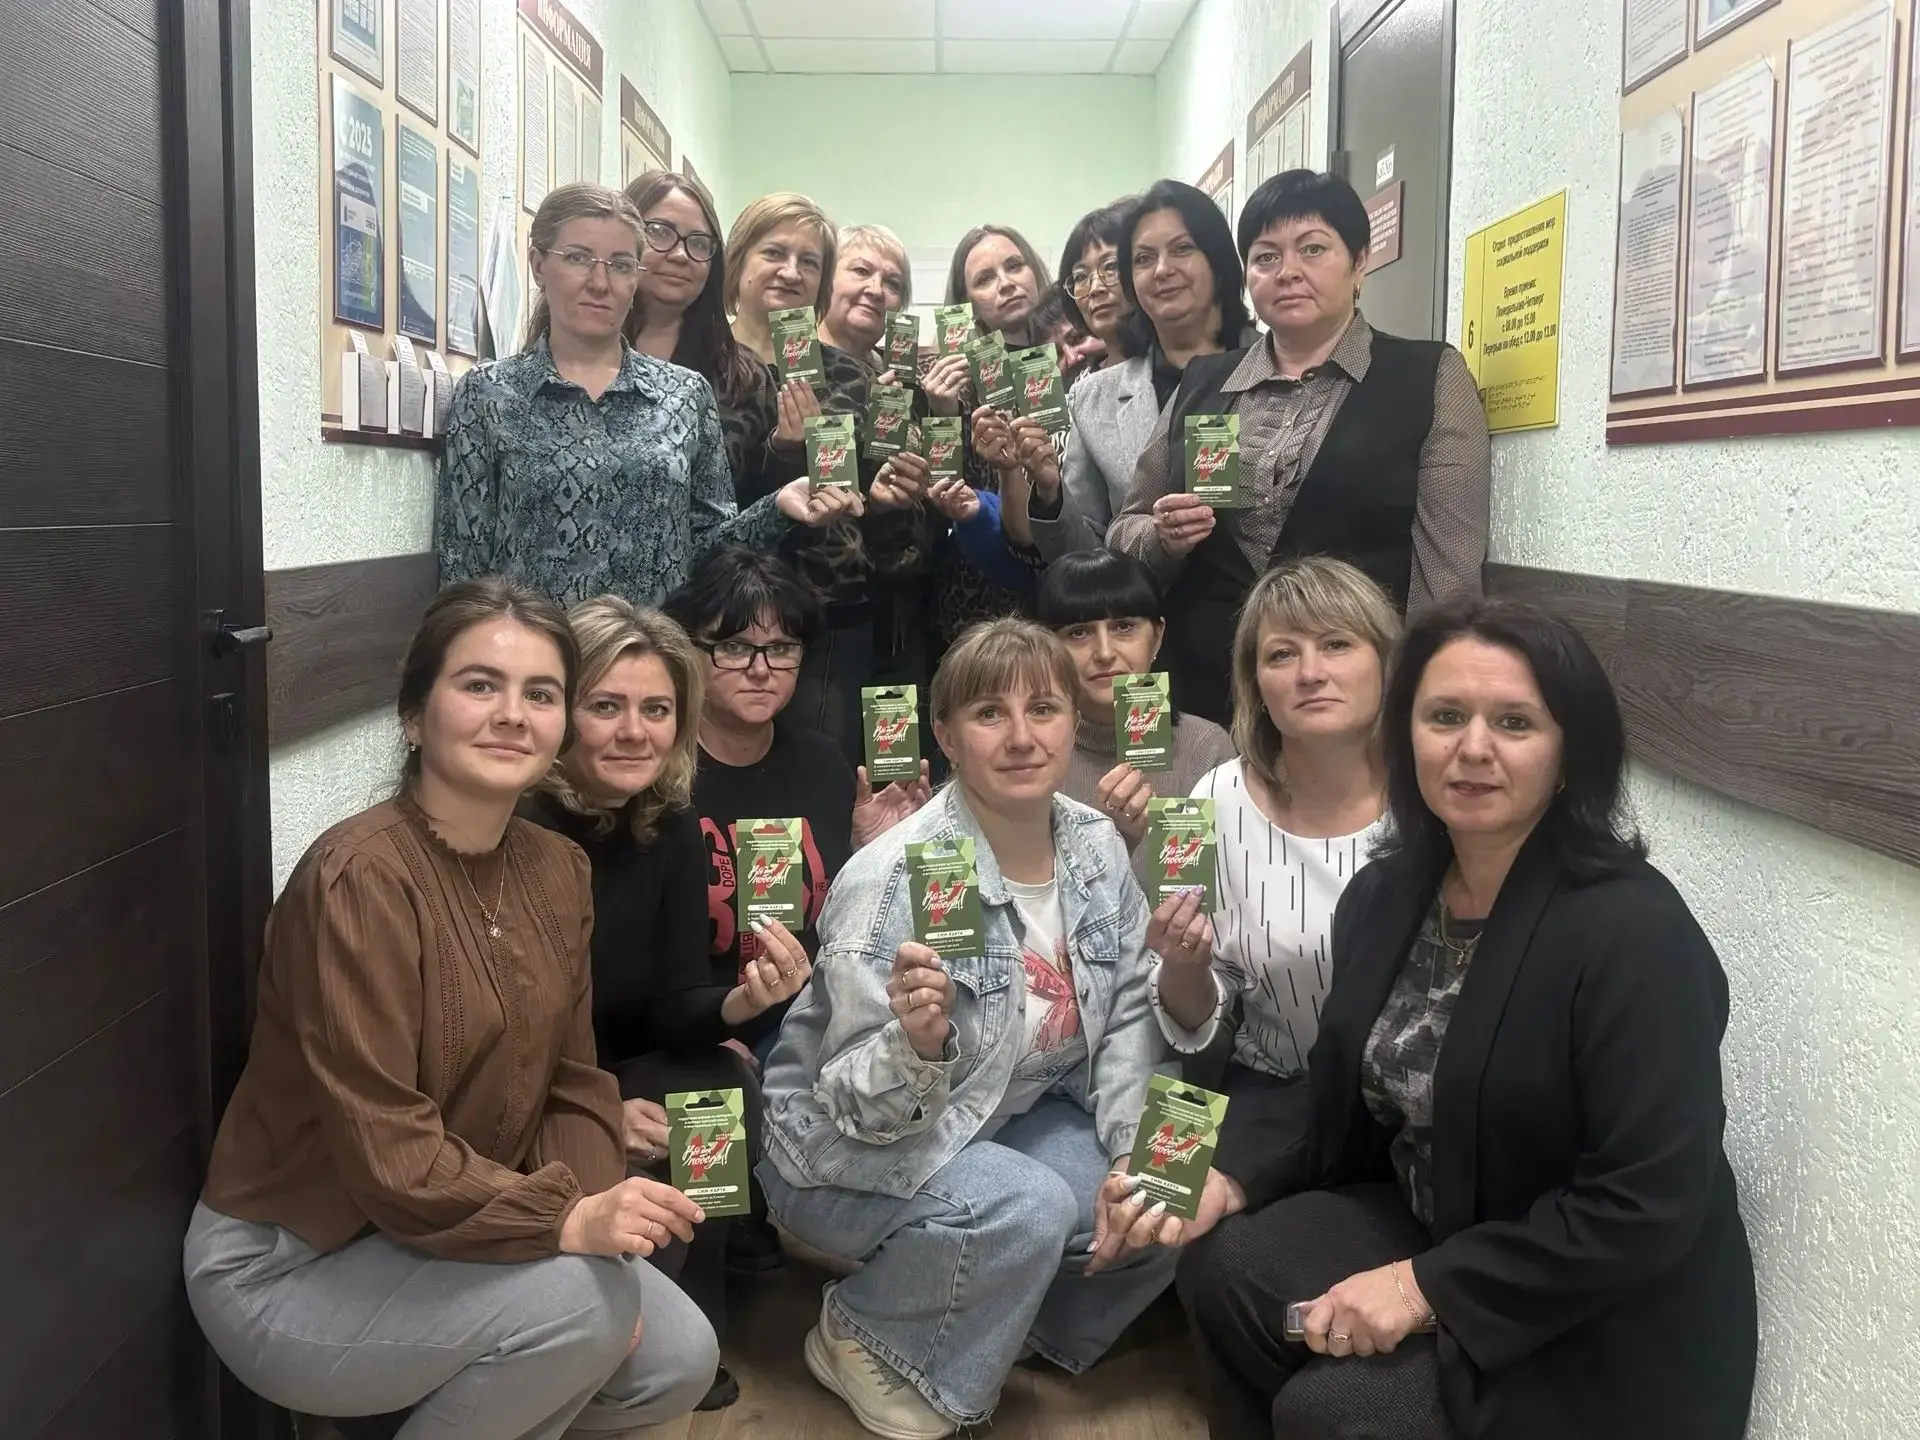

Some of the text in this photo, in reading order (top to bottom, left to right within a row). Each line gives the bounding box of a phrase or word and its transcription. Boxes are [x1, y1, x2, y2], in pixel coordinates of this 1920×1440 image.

[537, 0, 591, 70] ИНФОРМАЦИЯ
[348, 115, 372, 158] 2025
[1468, 319, 1474, 350] 6
[721, 859, 734, 888] DOPE
